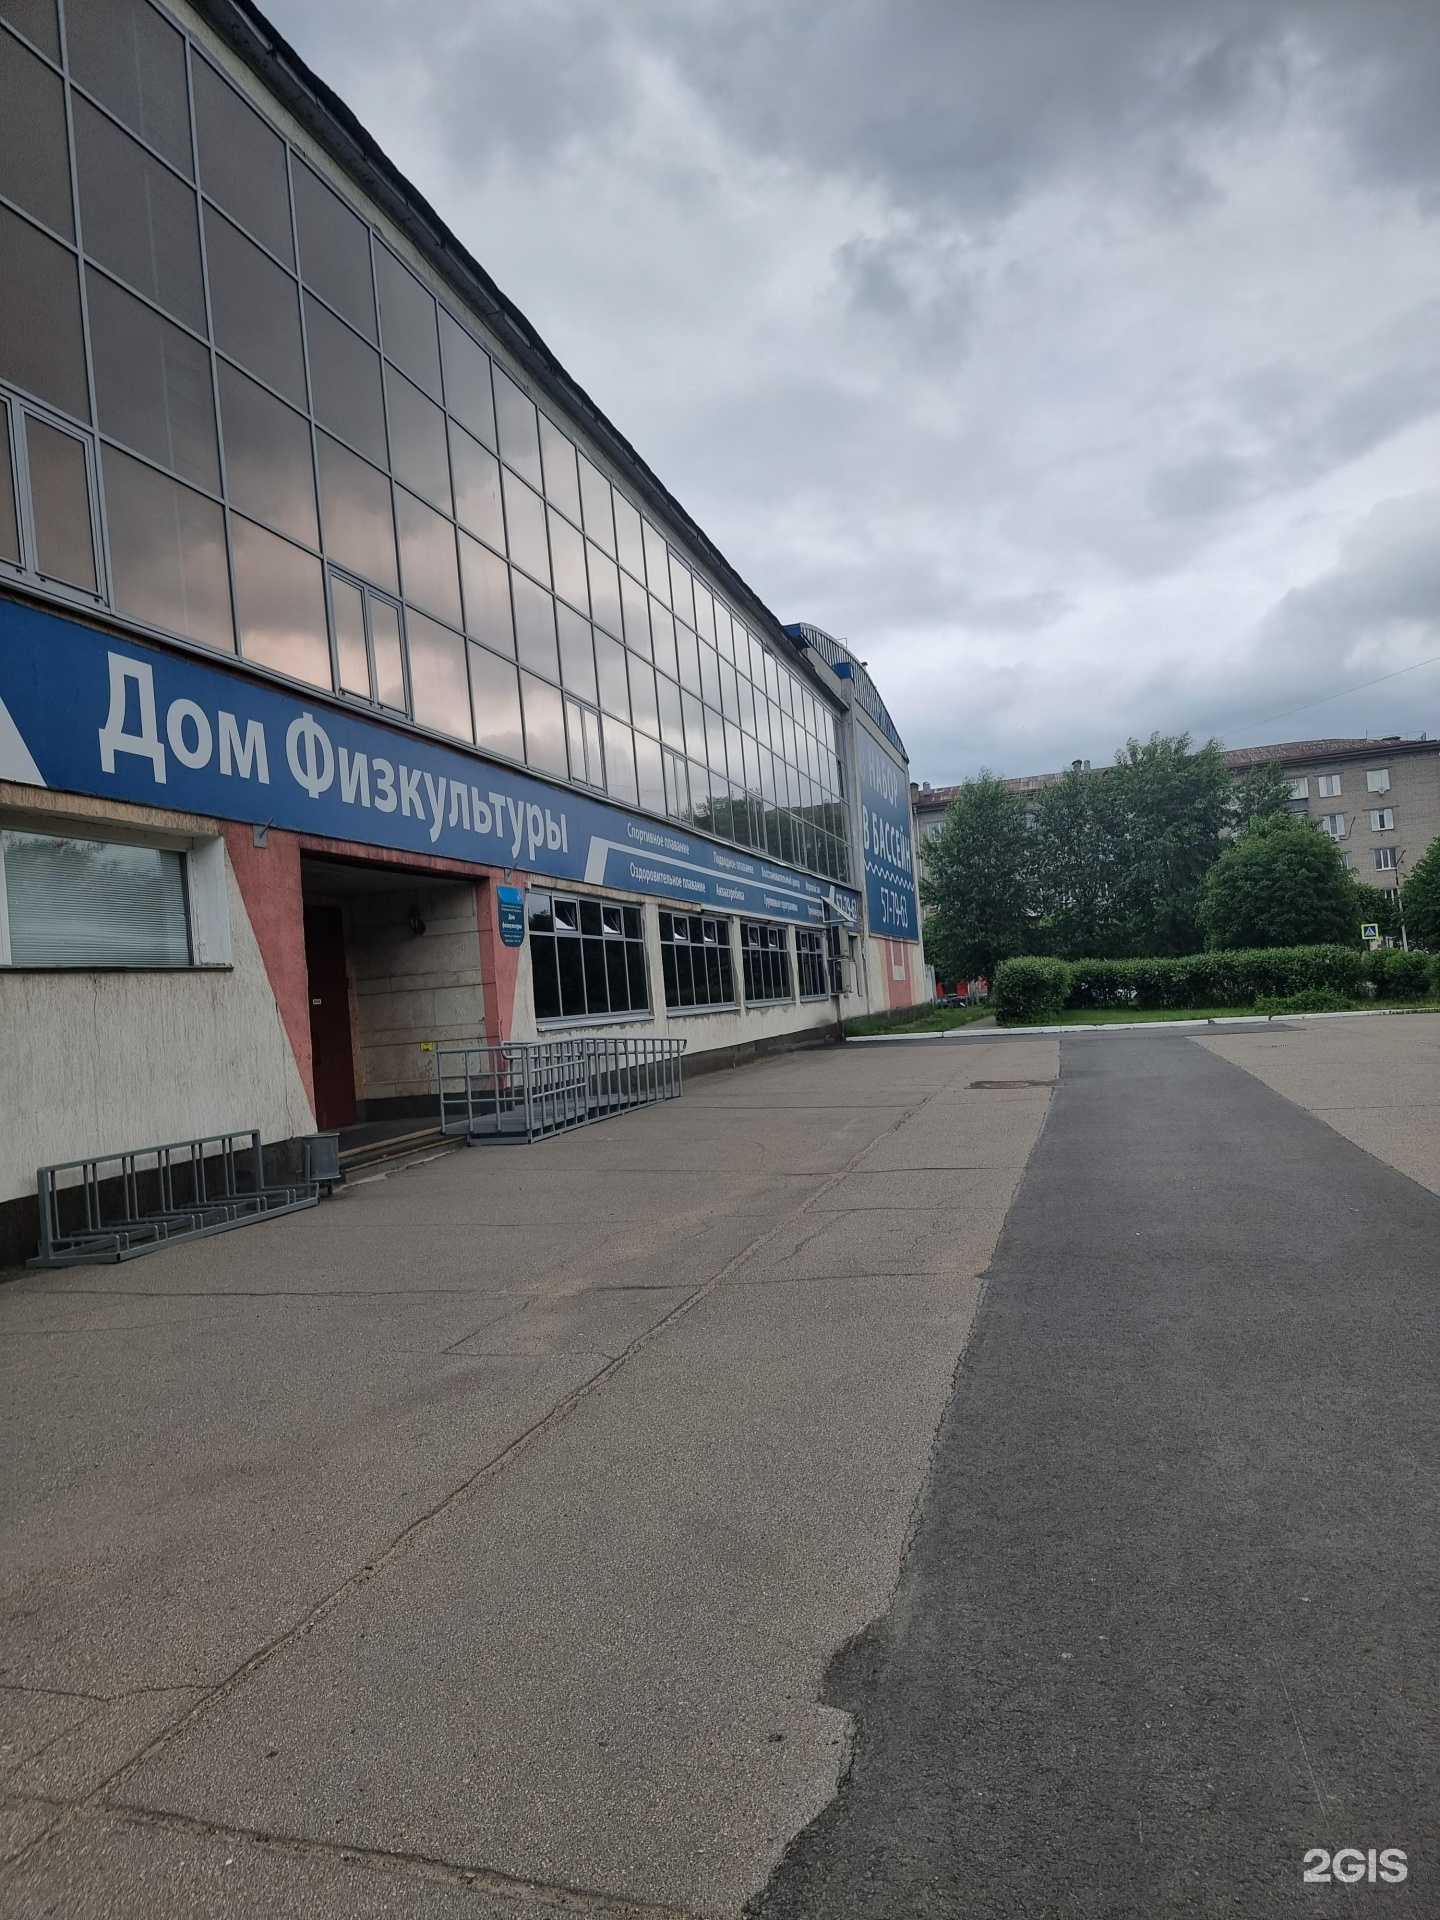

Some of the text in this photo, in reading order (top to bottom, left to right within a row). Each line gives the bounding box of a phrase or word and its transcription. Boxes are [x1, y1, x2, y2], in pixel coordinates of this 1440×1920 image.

[98, 650, 569, 862] Дом Физкультуры
[626, 822, 665, 847] Спортивное
[862, 804, 912, 874] В БАССЕЙН
[629, 861, 682, 887] Оздоровительное
